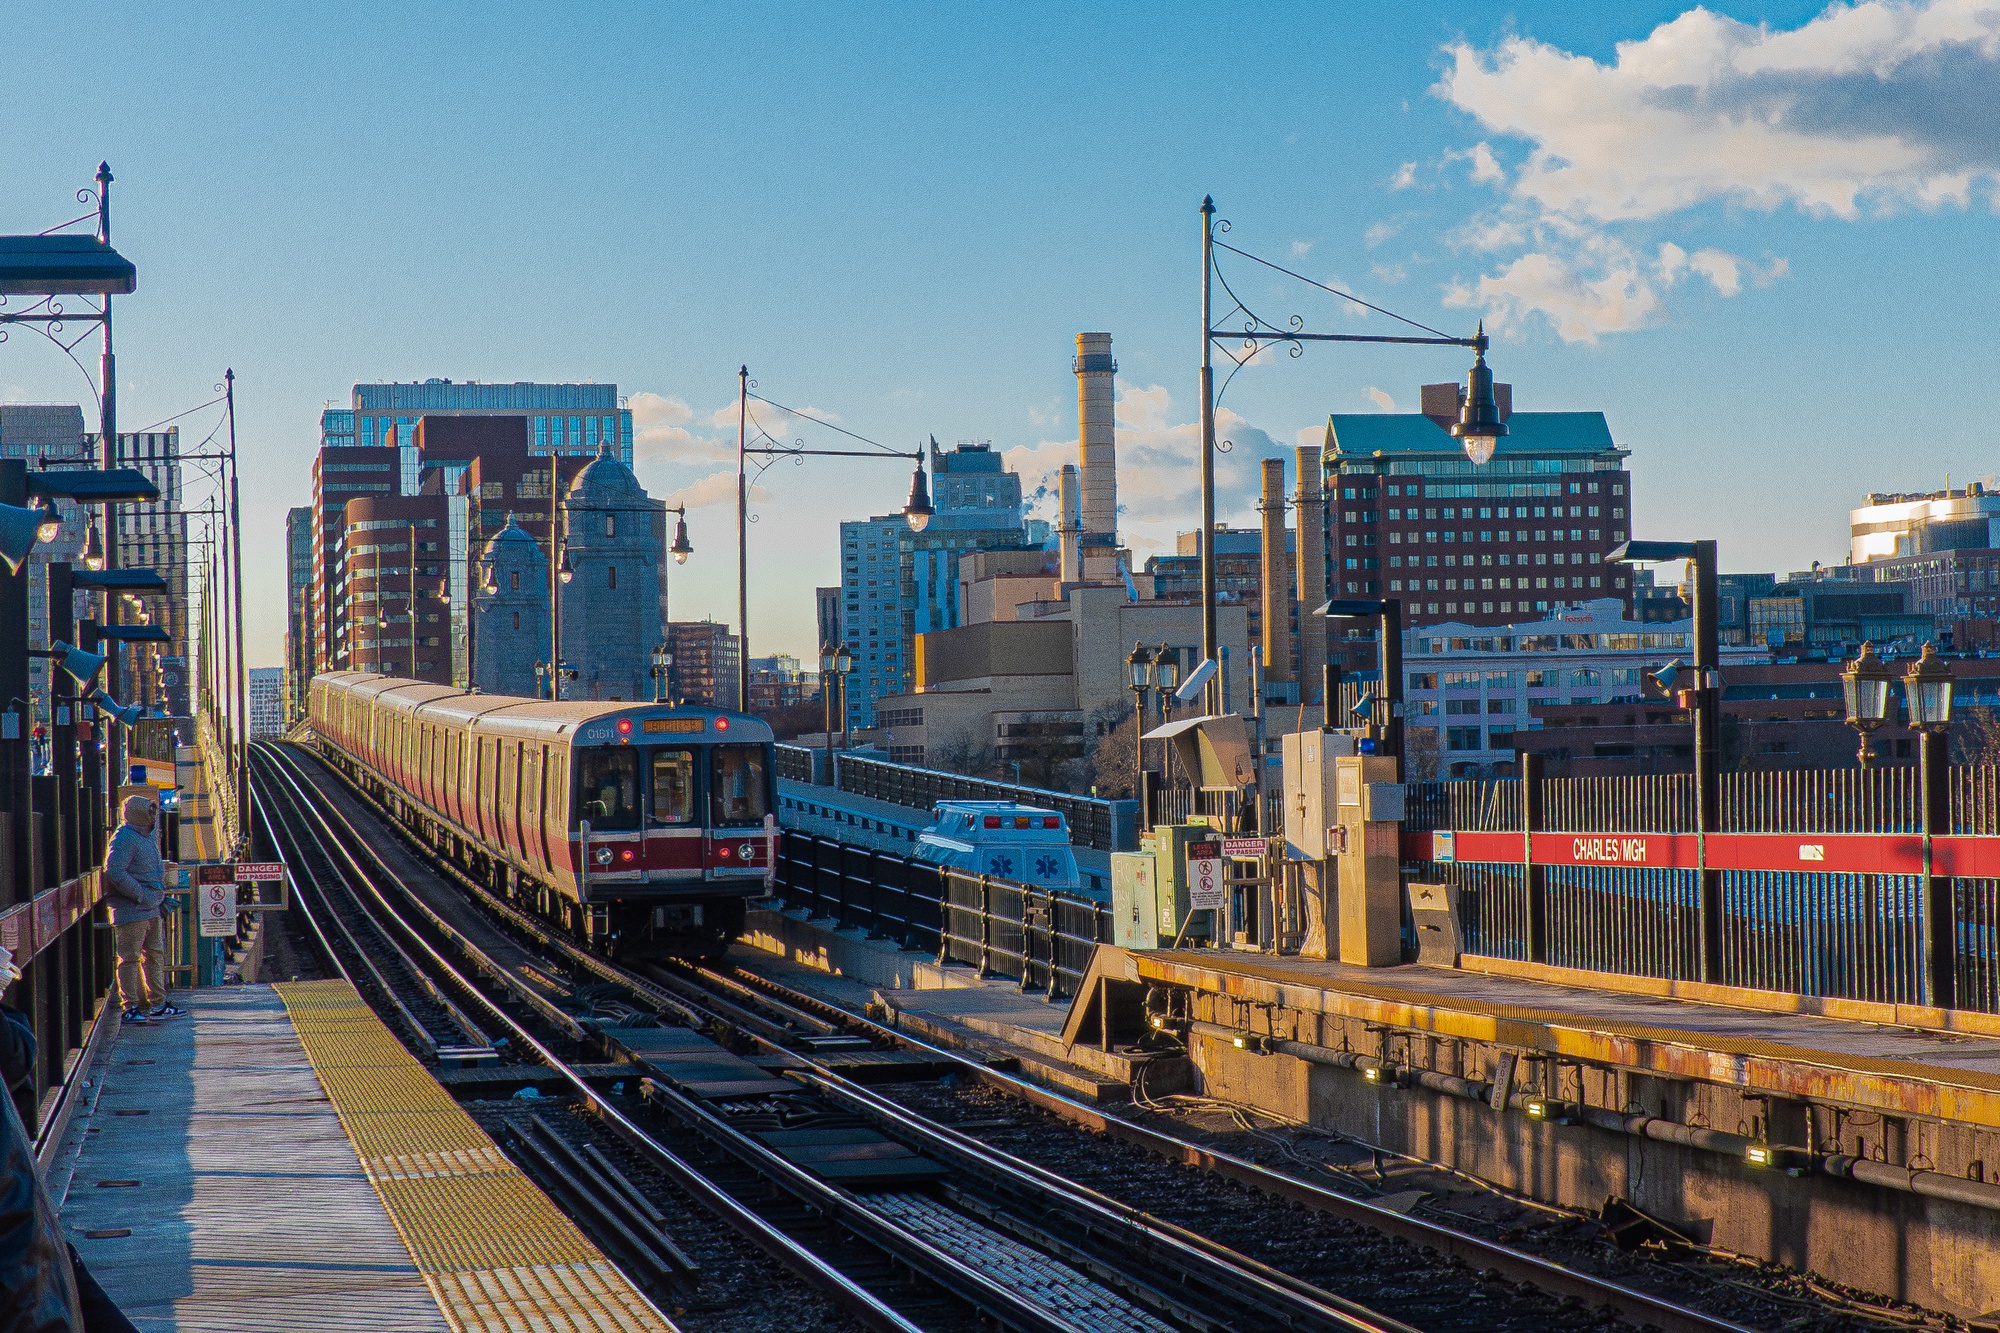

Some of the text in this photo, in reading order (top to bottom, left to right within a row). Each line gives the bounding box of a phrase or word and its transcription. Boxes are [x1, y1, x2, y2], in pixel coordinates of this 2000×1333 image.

[1225, 840, 1263, 848] DANGER
[1573, 837, 1646, 862] CHARLES/MGH
[238, 865, 280, 873] DANGER
